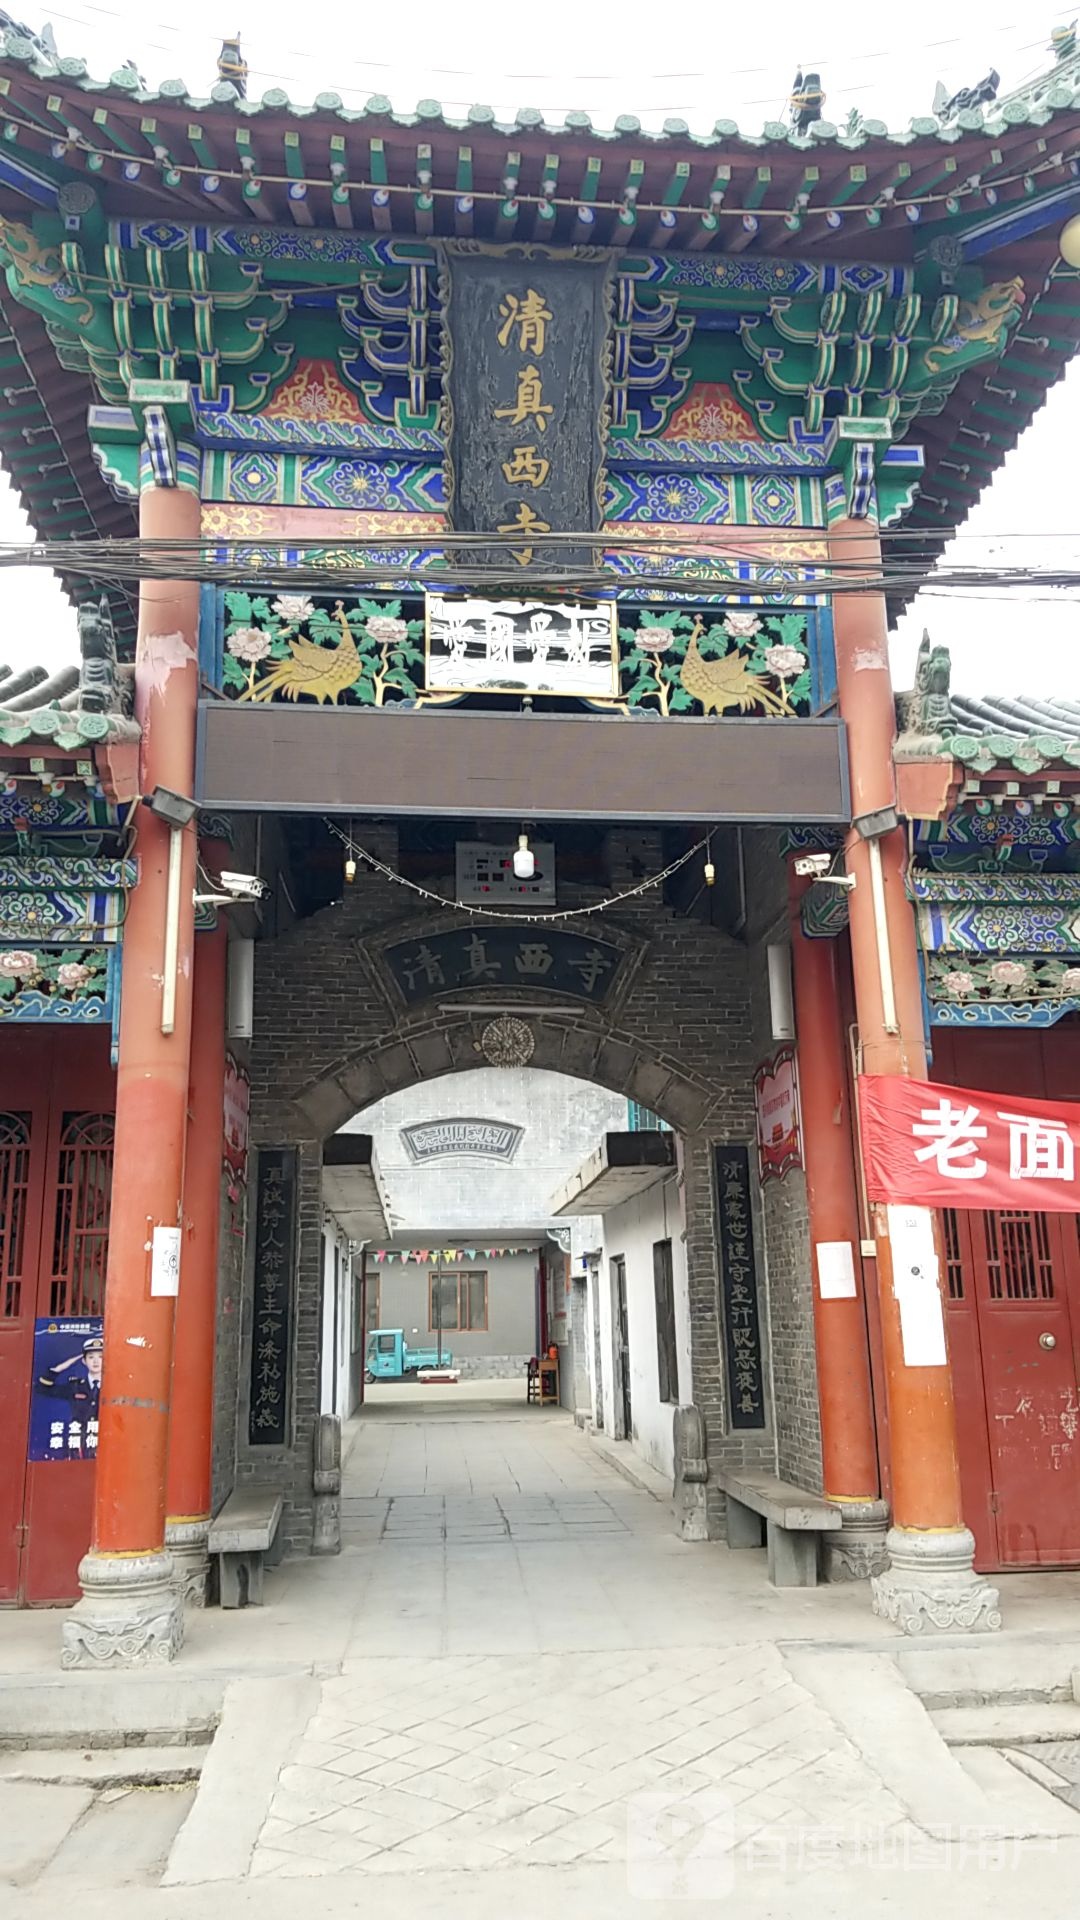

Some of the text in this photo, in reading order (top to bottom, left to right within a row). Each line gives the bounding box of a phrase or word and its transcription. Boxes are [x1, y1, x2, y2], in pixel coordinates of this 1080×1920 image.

[494, 287, 554, 566] 清真西寺
[402, 933, 612, 993] 清真西寺
[912, 1098, 1075, 1181] 老面
[49, 1435, 99, 1449] 幸福你
[50, 1420, 99, 1434] 安全用
